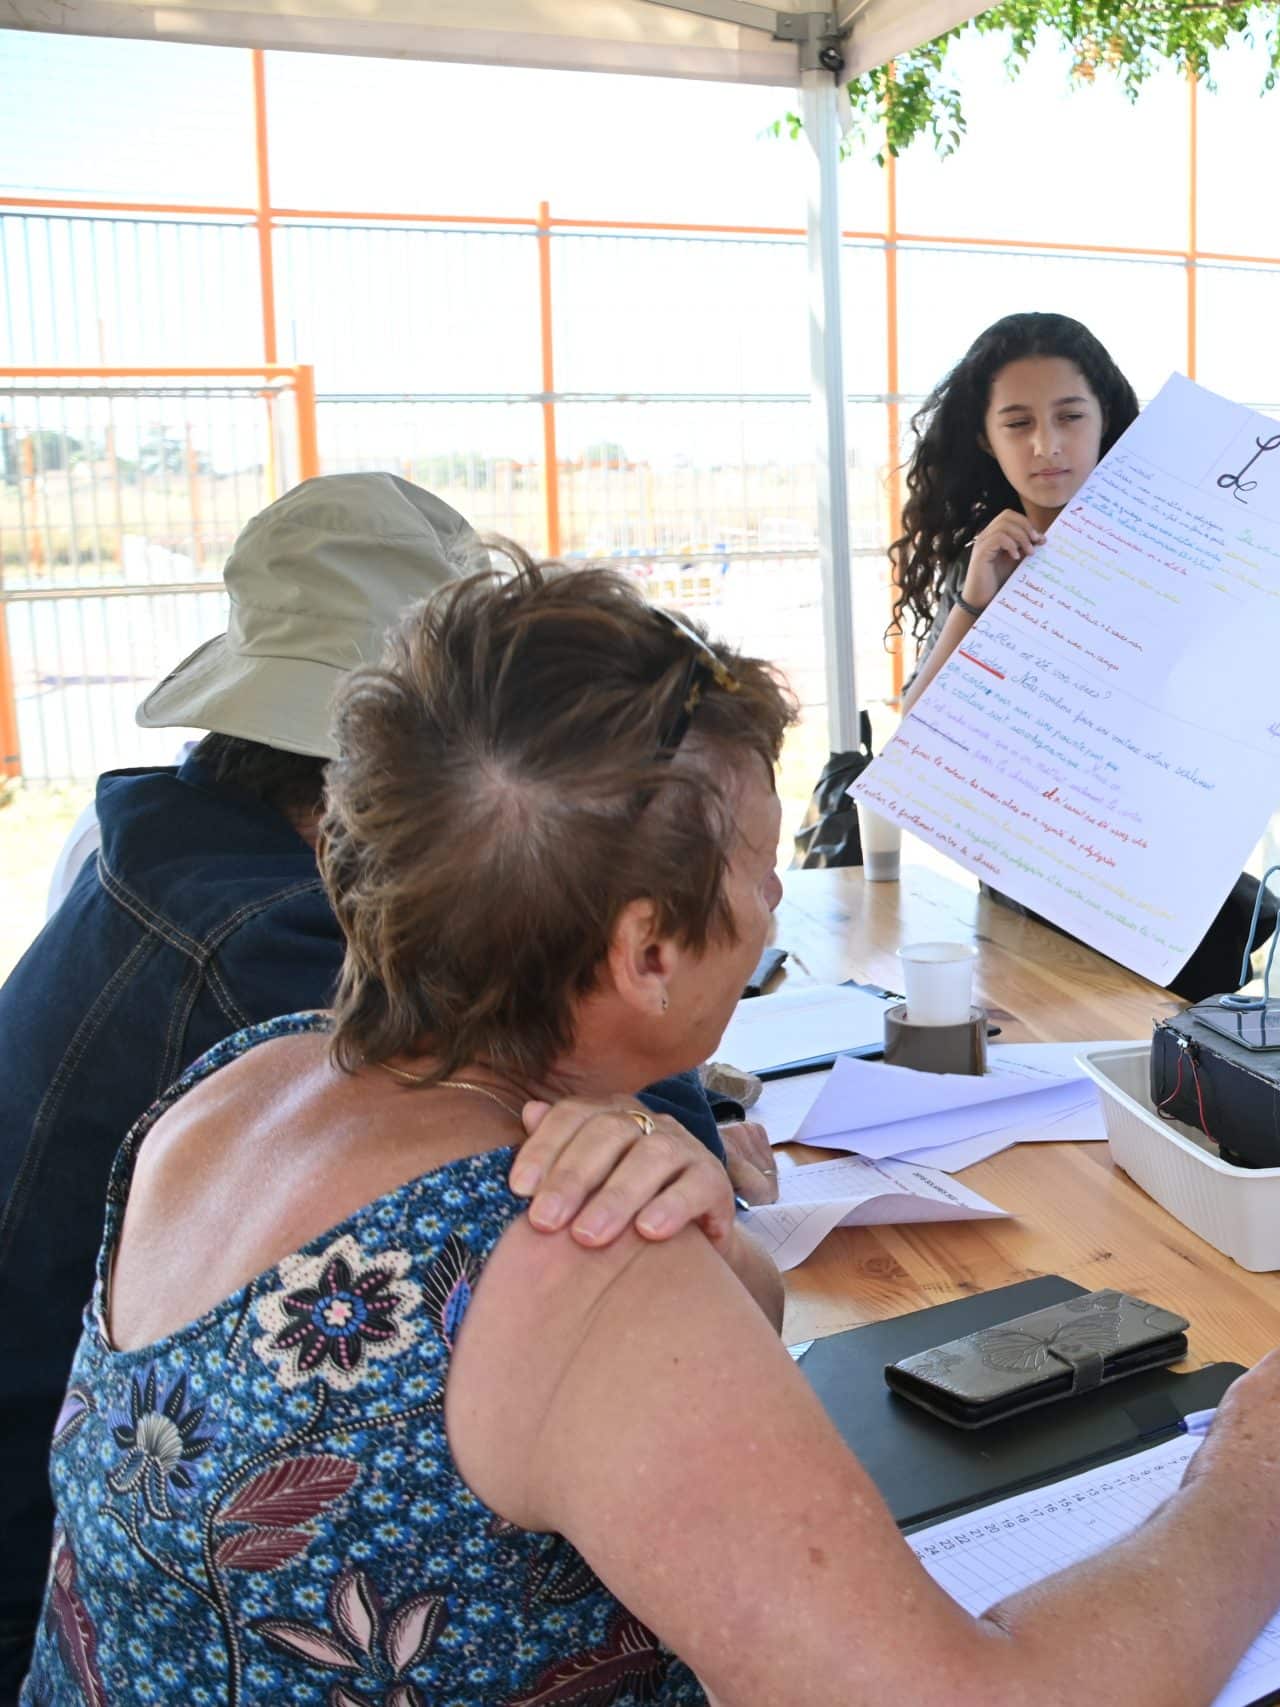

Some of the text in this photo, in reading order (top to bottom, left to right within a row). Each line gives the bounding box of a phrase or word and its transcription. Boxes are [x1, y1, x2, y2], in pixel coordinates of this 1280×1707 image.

[1044, 1503, 1059, 1513] 16
[1058, 1498, 1073, 1508] 15
[1030, 1508, 1045, 1518] 17
[1016, 1513, 1030, 1524] 18
[1002, 1519, 1016, 1529] 19
[954, 1534, 971, 1545] 22
[924, 1544, 940, 1556] 24
